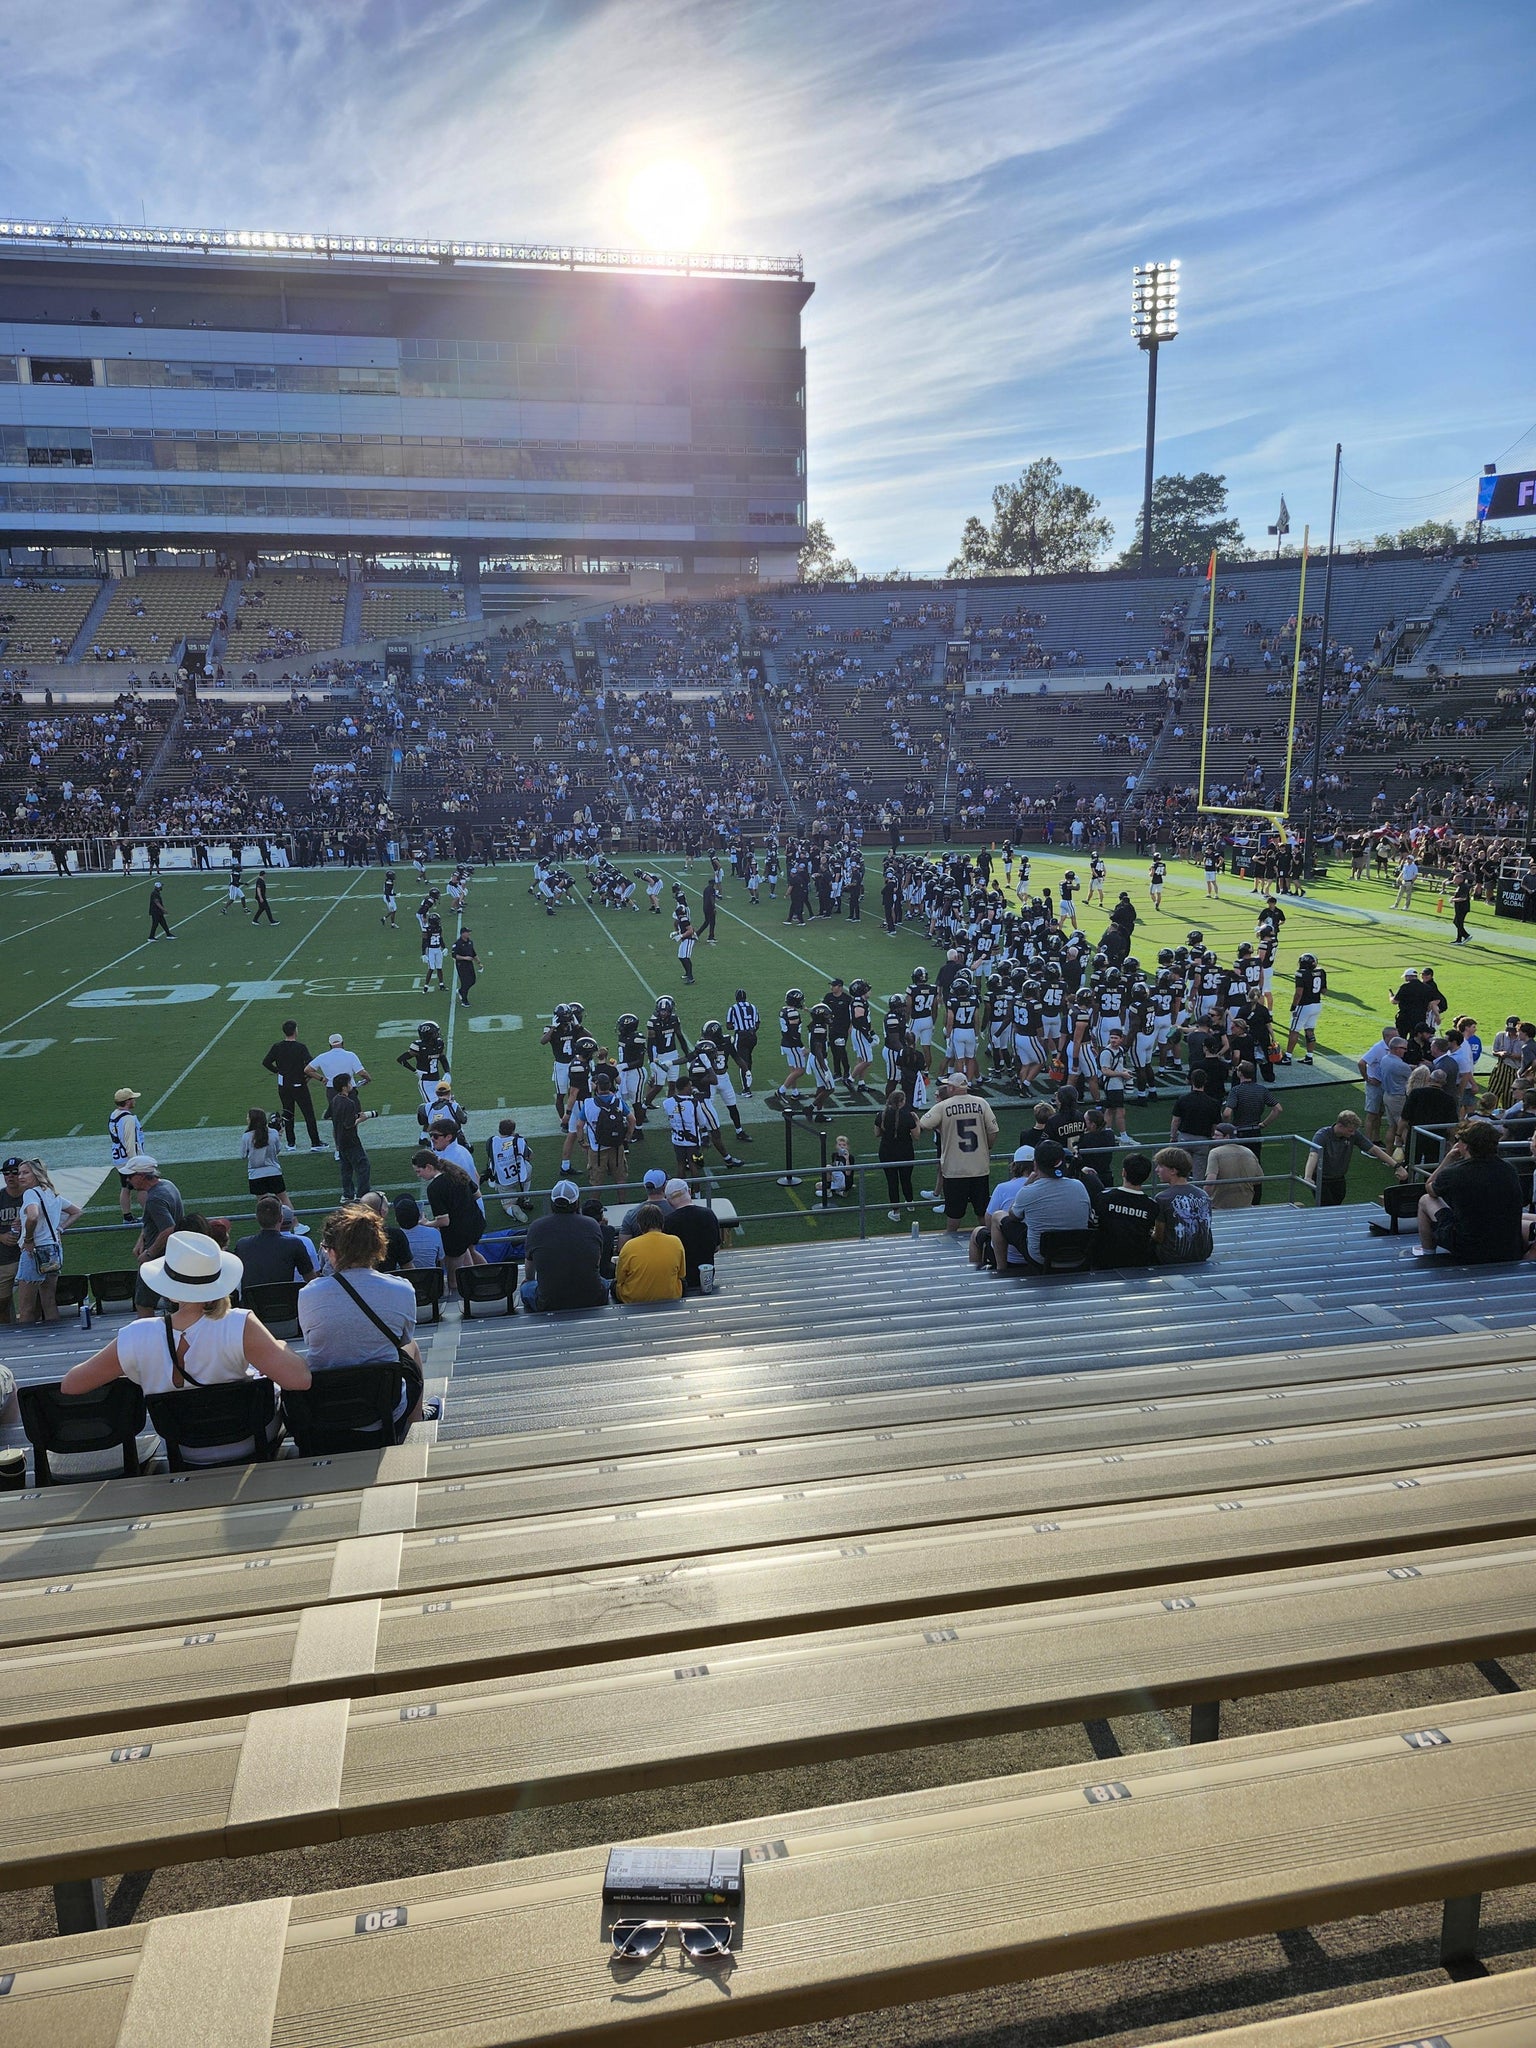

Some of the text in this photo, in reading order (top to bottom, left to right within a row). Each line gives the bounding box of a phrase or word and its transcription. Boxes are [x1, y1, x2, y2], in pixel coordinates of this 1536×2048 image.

[1518, 480, 1536, 506] F
[914, 995, 935, 1011] 34
[1043, 989, 1063, 1006] 45
[1101, 993, 1122, 1011] 35
[955, 1007, 976, 1024] 47
[563, 1040, 573, 1055] 4
[946, 1103, 983, 1117] CORREA
[956, 1119, 978, 1152] 5
[1109, 1203, 1148, 1219] PURDUE
[1392, 1568, 1415, 1577] 16
[428, 1603, 446, 1612] 20
[1172, 1599, 1189, 1609] 17
[190, 1635, 209, 1644] 21
[931, 1631, 951, 1642] 18
[407, 1706, 430, 1719] 20
[1415, 1731, 1441, 1747] 17
[118, 1747, 143, 1761] 21
[1091, 1785, 1122, 1802] 18
[748, 1845, 778, 1861] 19
[364, 1908, 398, 1931] 20
